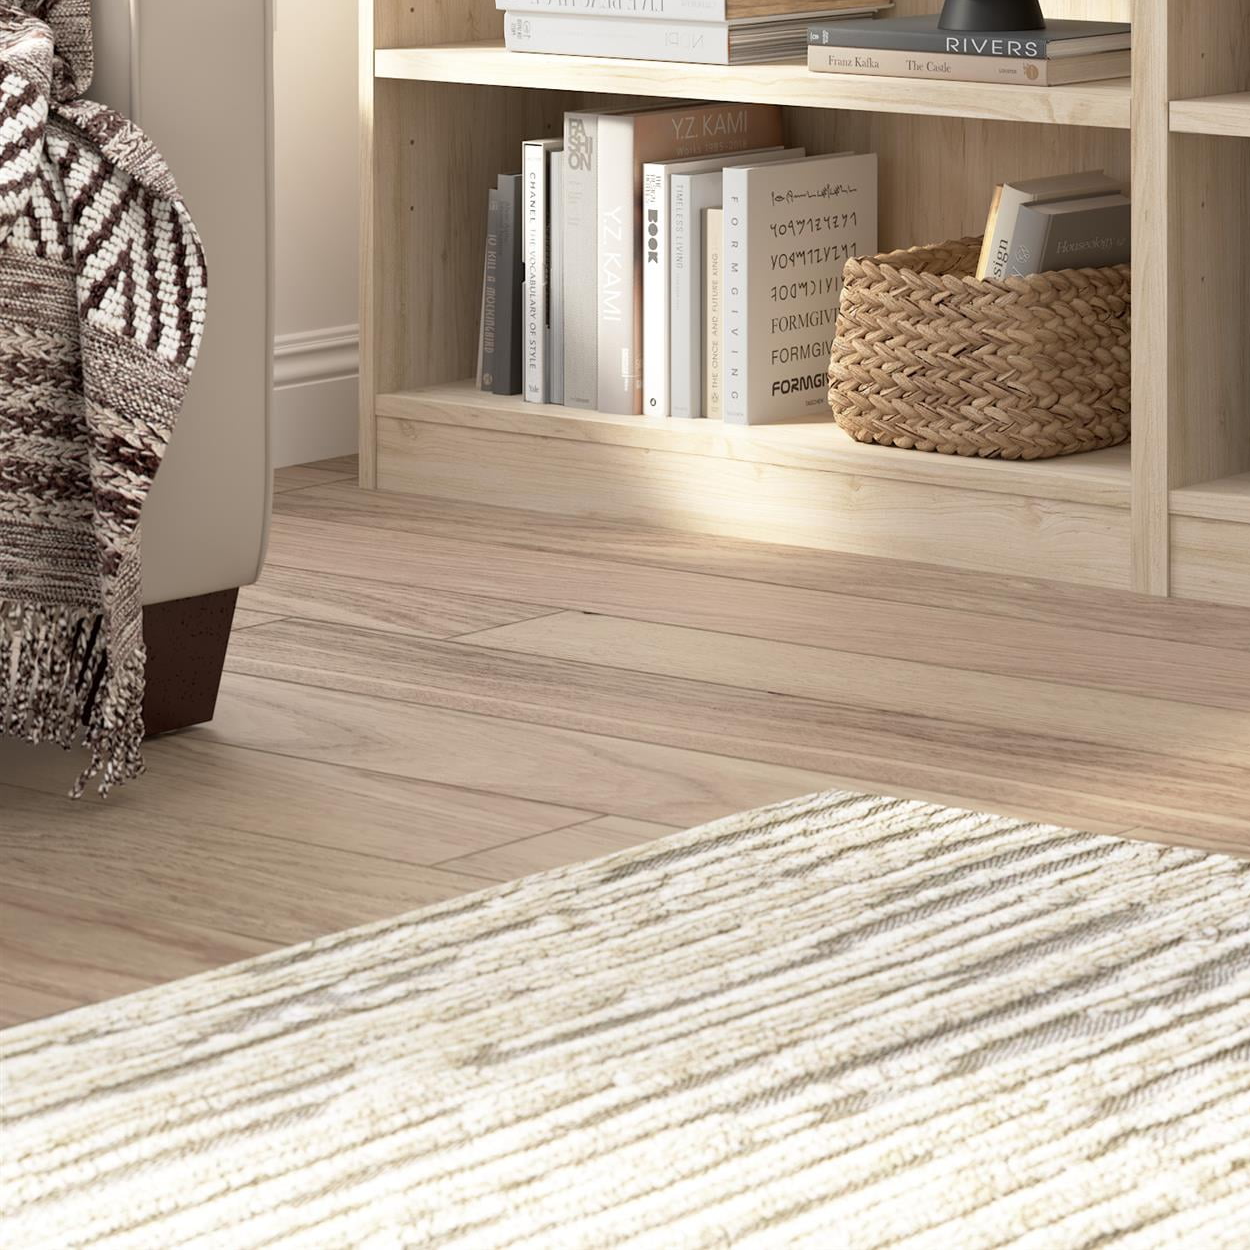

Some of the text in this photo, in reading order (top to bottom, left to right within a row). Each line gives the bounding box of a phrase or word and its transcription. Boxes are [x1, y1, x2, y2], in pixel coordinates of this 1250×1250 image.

[828, 55, 951, 73] Franz Kafka The Castle
[946, 37, 1038, 57] RIVERS
[672, 110, 748, 140] Y.Z. KAMI
[676, 184, 684, 232] TIMELESS
[648, 209, 658, 264] BOOK
[676, 236, 684, 269] LIVING
[487, 251, 496, 270] KILL
[603, 206, 621, 322] Y.Z. KAMI
[992, 238, 1008, 280] sign
[730, 196, 740, 400] FORMGIVING
[484, 287, 496, 353] MOCKINGBIRD
[529, 323, 536, 336] OF
